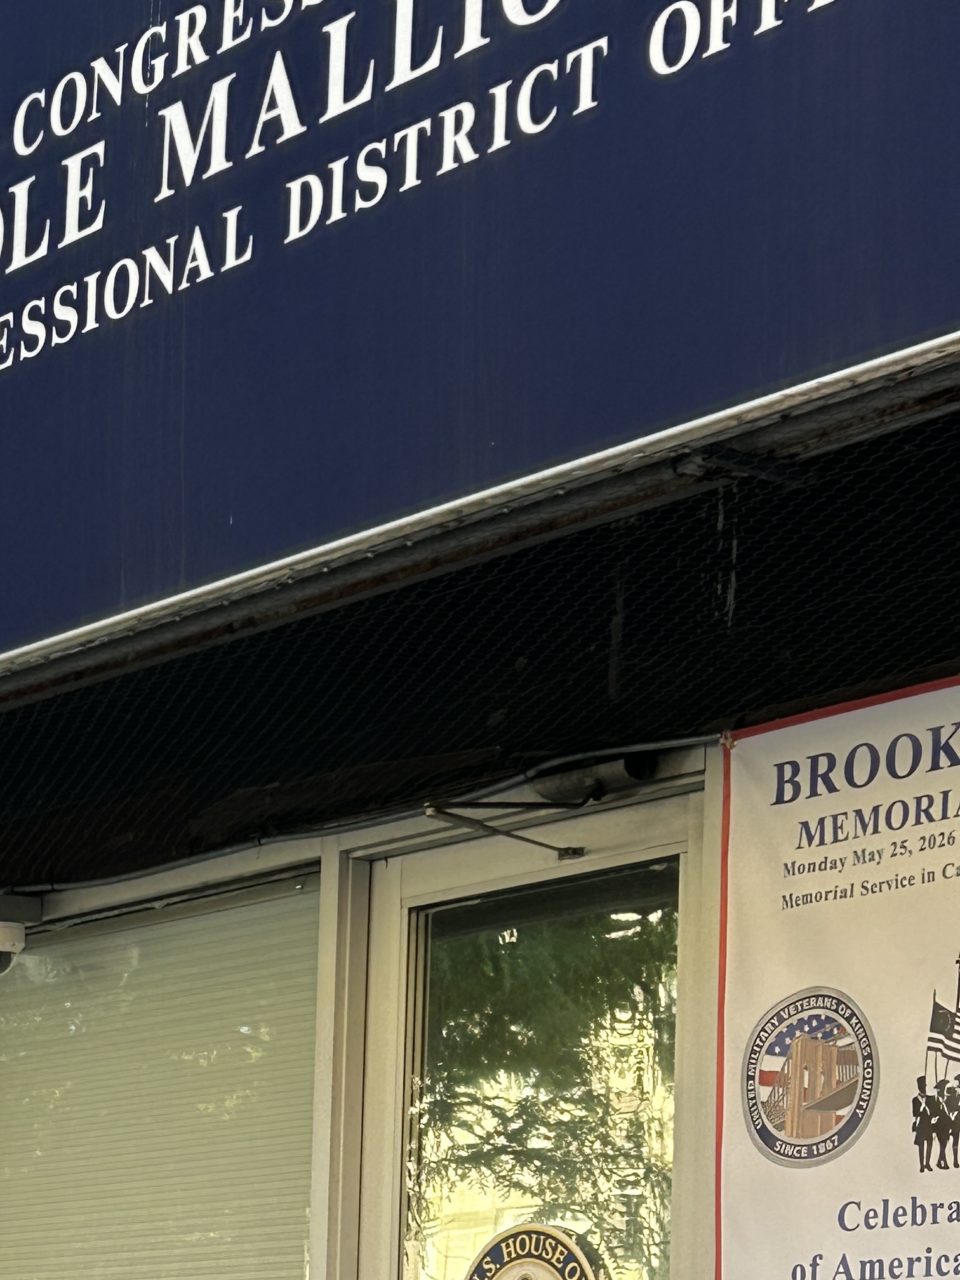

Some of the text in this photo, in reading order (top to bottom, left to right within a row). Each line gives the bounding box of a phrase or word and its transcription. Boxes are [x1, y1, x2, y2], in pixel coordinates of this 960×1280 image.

[153, 0, 564, 203] MALLI
[284, 37, 608, 244] DISTRICT
[795, 790, 960, 850] MEMORI
[783, 829, 956, 879] Monday May 25, 2026
[781, 882, 854, 910] Memorial
[860, 874, 915, 896] Service
[921, 867, 935, 884] in
[779, 996, 838, 1020] VETERANS
[838, 1002, 851, 1019] OF
[748, 1016, 779, 1077] MILITARY
[849, 1015, 871, 1056] KINGS
[857, 1059, 873, 1118] COUNTY
[774, 1140, 808, 1158] SINCE
[837, 1196, 960, 1231] Celebra
[502, 1233, 568, 1267] HOUSE
